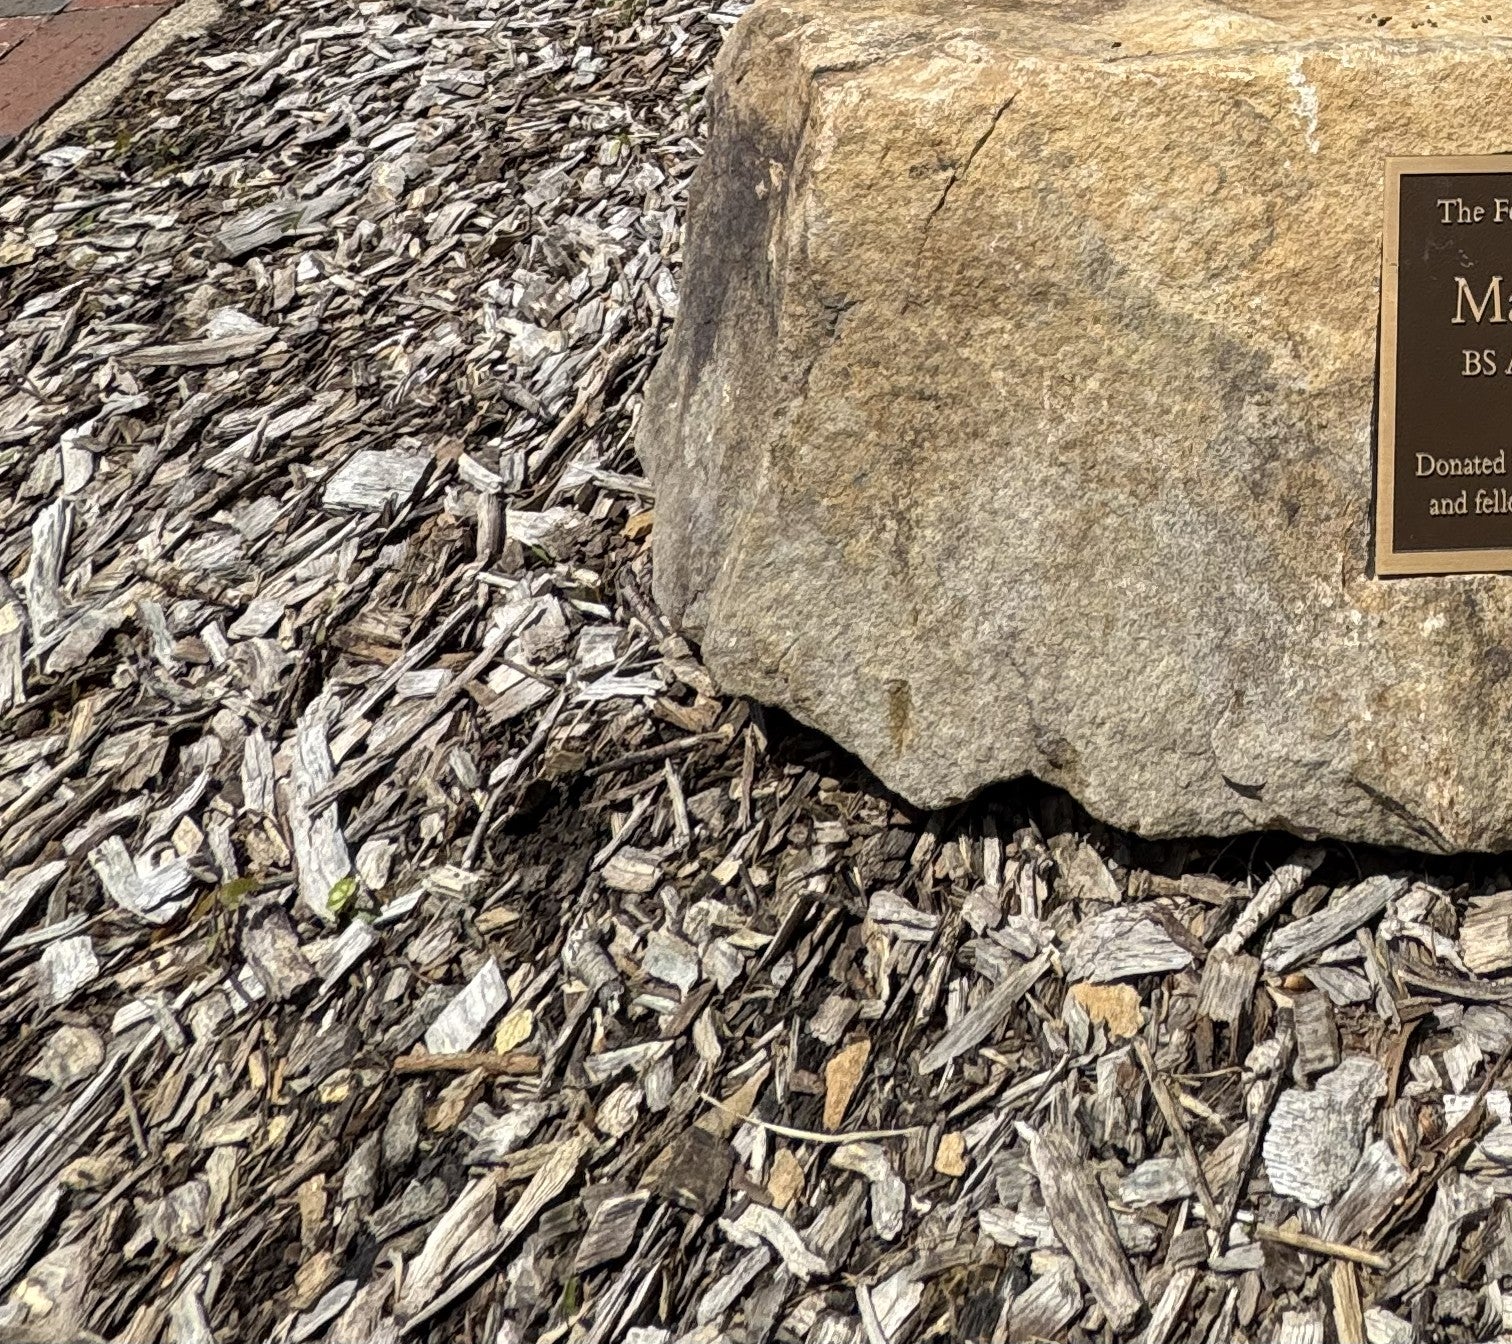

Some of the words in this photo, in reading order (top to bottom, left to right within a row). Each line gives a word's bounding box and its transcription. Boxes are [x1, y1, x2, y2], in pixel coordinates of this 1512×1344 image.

[1436, 197, 1486, 224] The
[1461, 349, 1497, 376] BS
[1415, 448, 1507, 477] Donated
[1429, 487, 1469, 516] and
